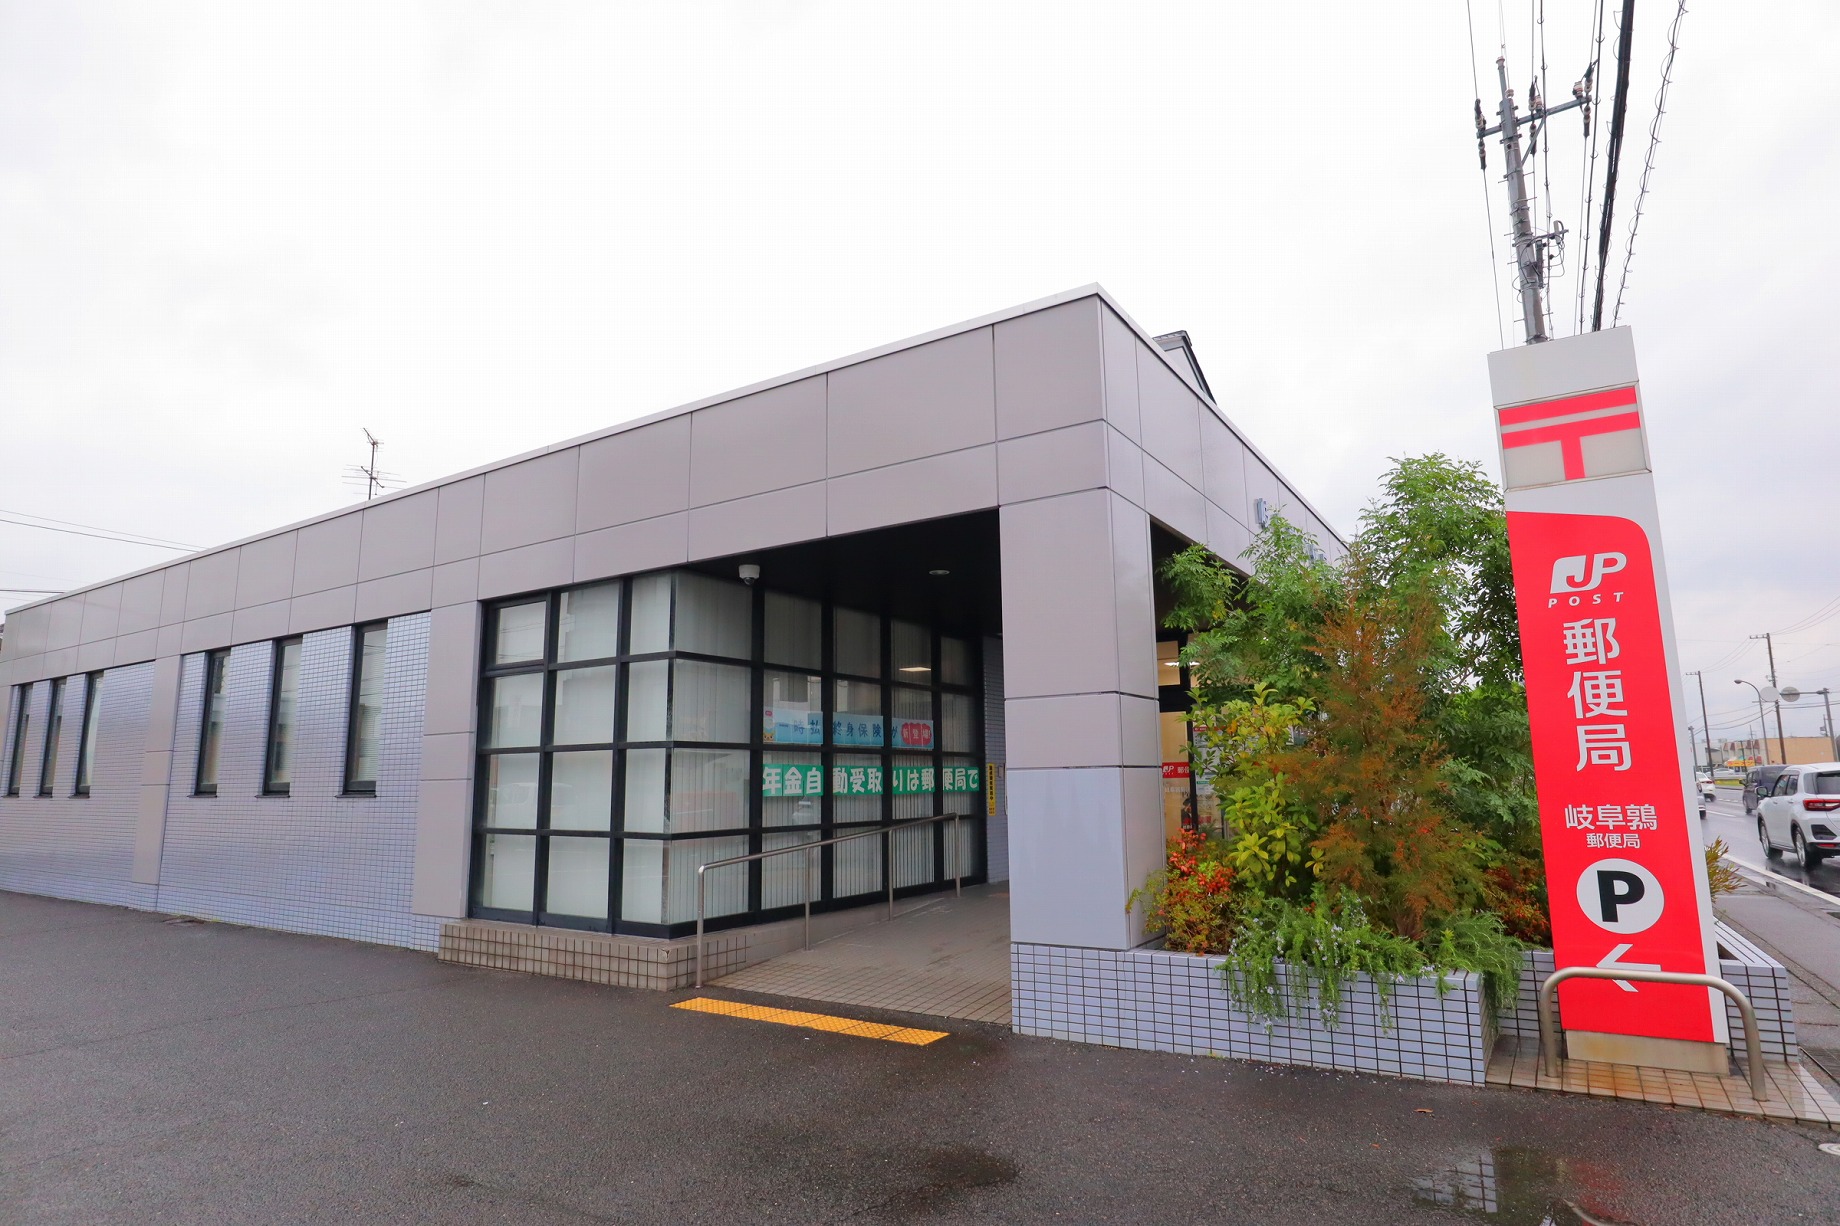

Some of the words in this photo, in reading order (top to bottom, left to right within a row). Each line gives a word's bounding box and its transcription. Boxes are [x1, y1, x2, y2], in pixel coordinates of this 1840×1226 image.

[1550, 551, 1627, 594] JP
[1547, 591, 1624, 609] POST
[1562, 617, 1632, 772] 郵便局
[1564, 804, 1658, 830] 岐阜鶉
[1586, 832, 1641, 849] 郵便局
[1596, 870, 1645, 922] P
